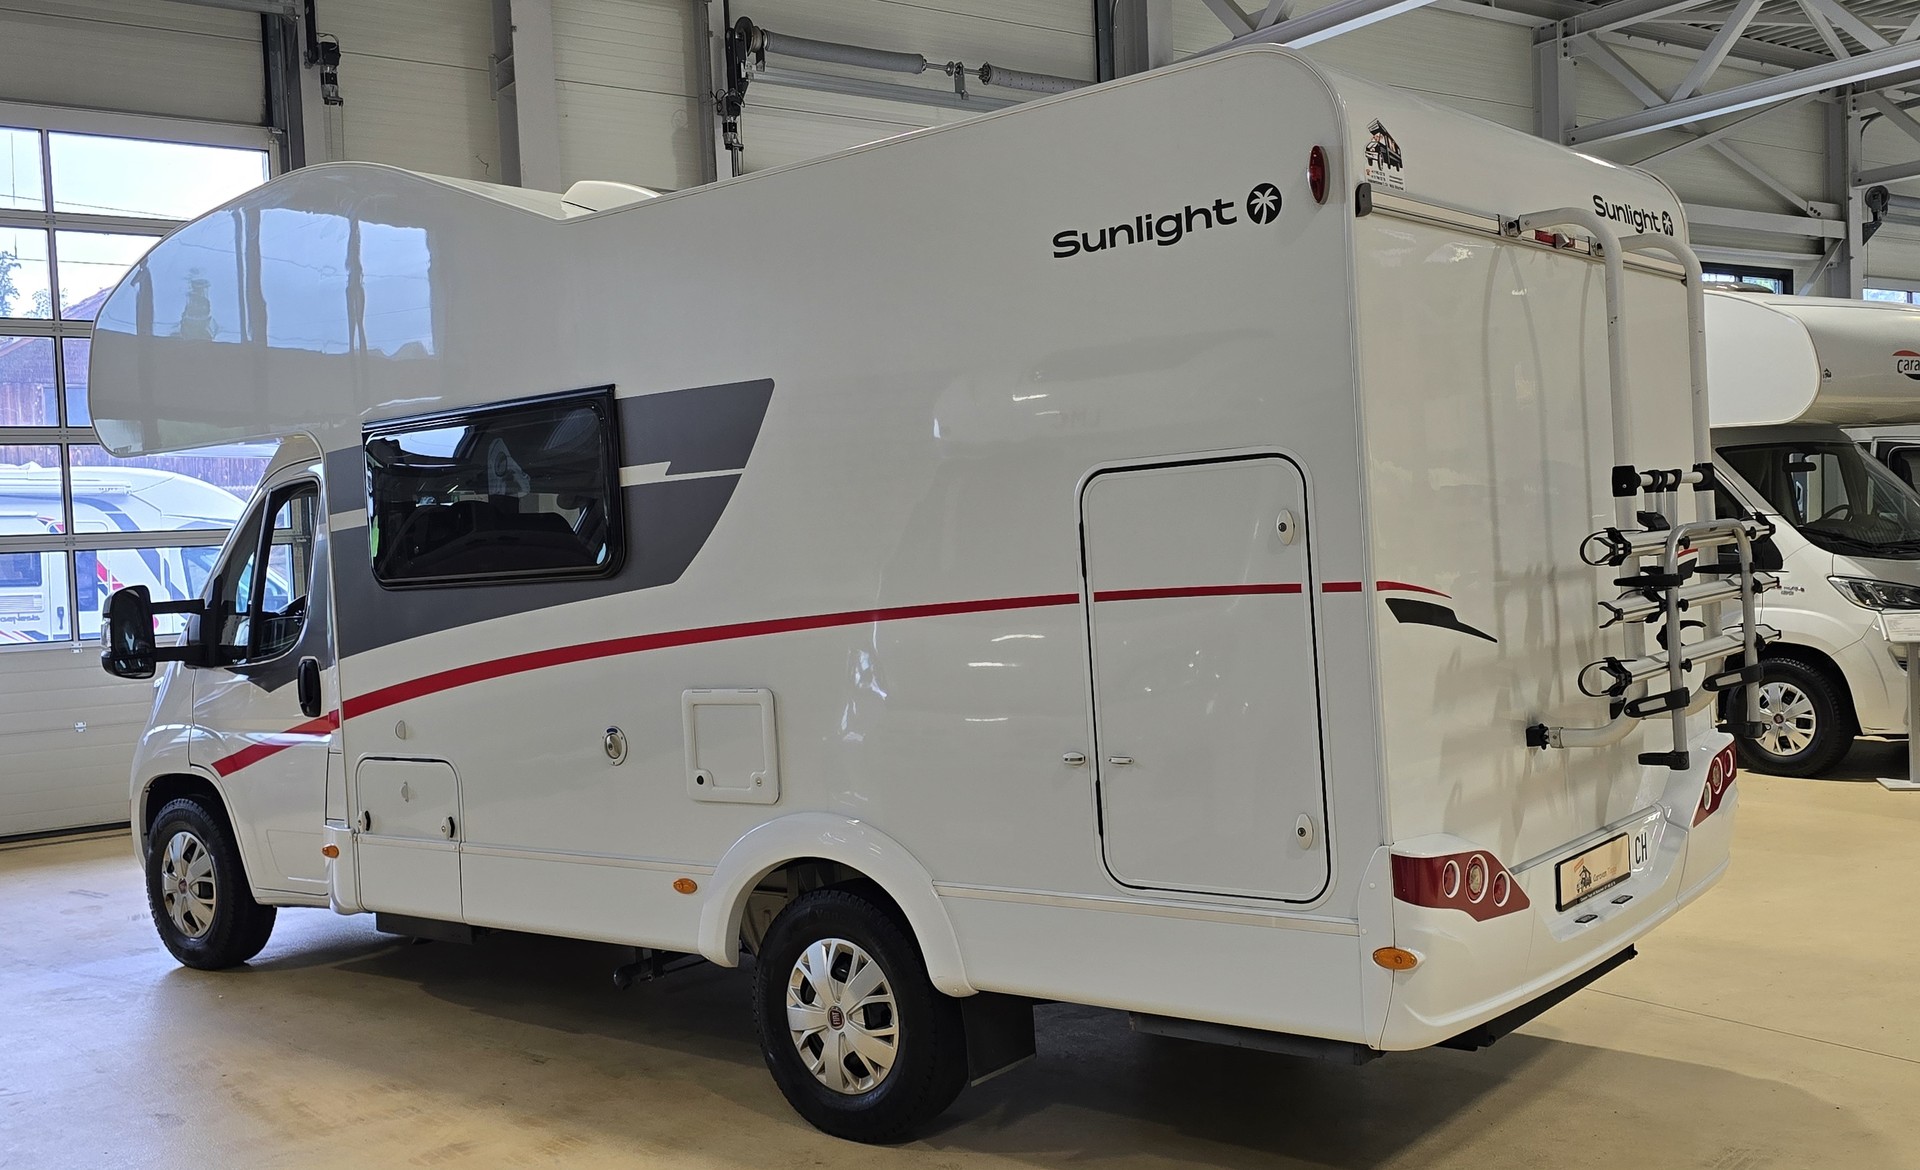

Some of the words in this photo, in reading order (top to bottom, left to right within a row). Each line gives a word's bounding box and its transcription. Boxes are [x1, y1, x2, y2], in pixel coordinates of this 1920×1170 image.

[1052, 198, 1238, 258] Sunlight
[1592, 194, 1661, 234] Sunlight
[1634, 832, 1648, 864] CH
[831, 1011, 841, 1026] FIAT
